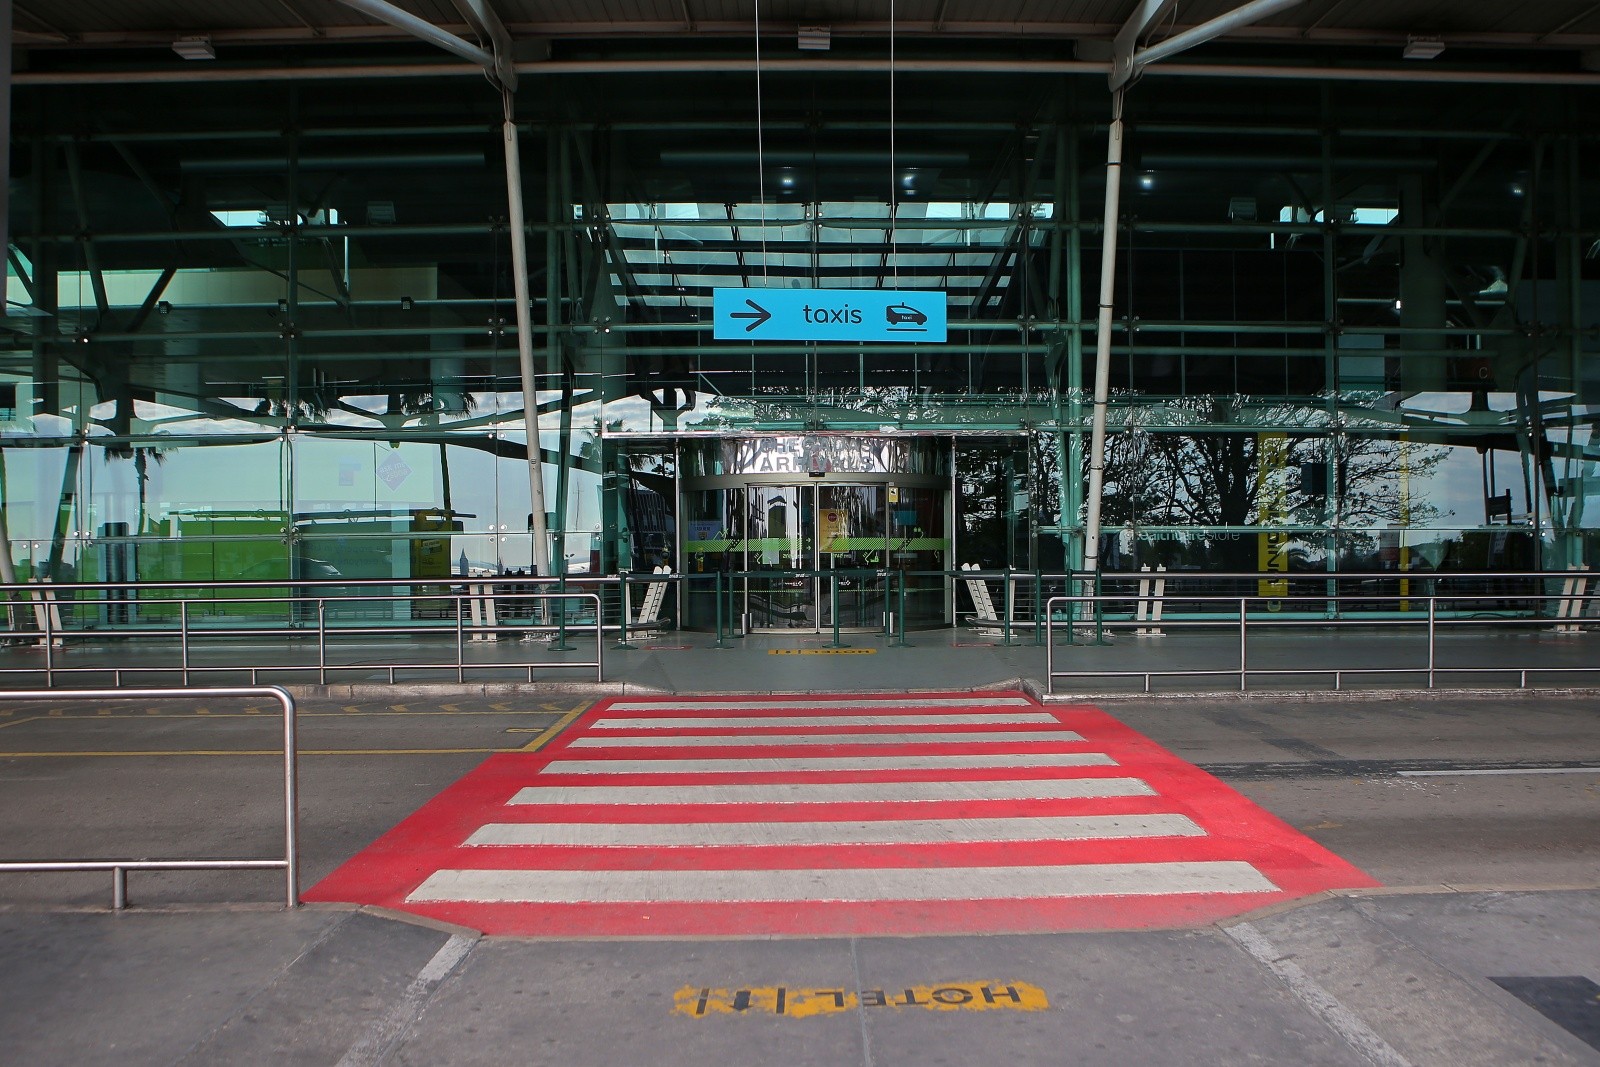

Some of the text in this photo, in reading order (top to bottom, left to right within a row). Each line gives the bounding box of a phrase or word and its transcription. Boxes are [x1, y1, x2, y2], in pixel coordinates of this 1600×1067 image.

[803, 303, 862, 325] taxis
[760, 455, 873, 473] ARRIVALS
[815, 985, 1021, 1008] HOTEL
